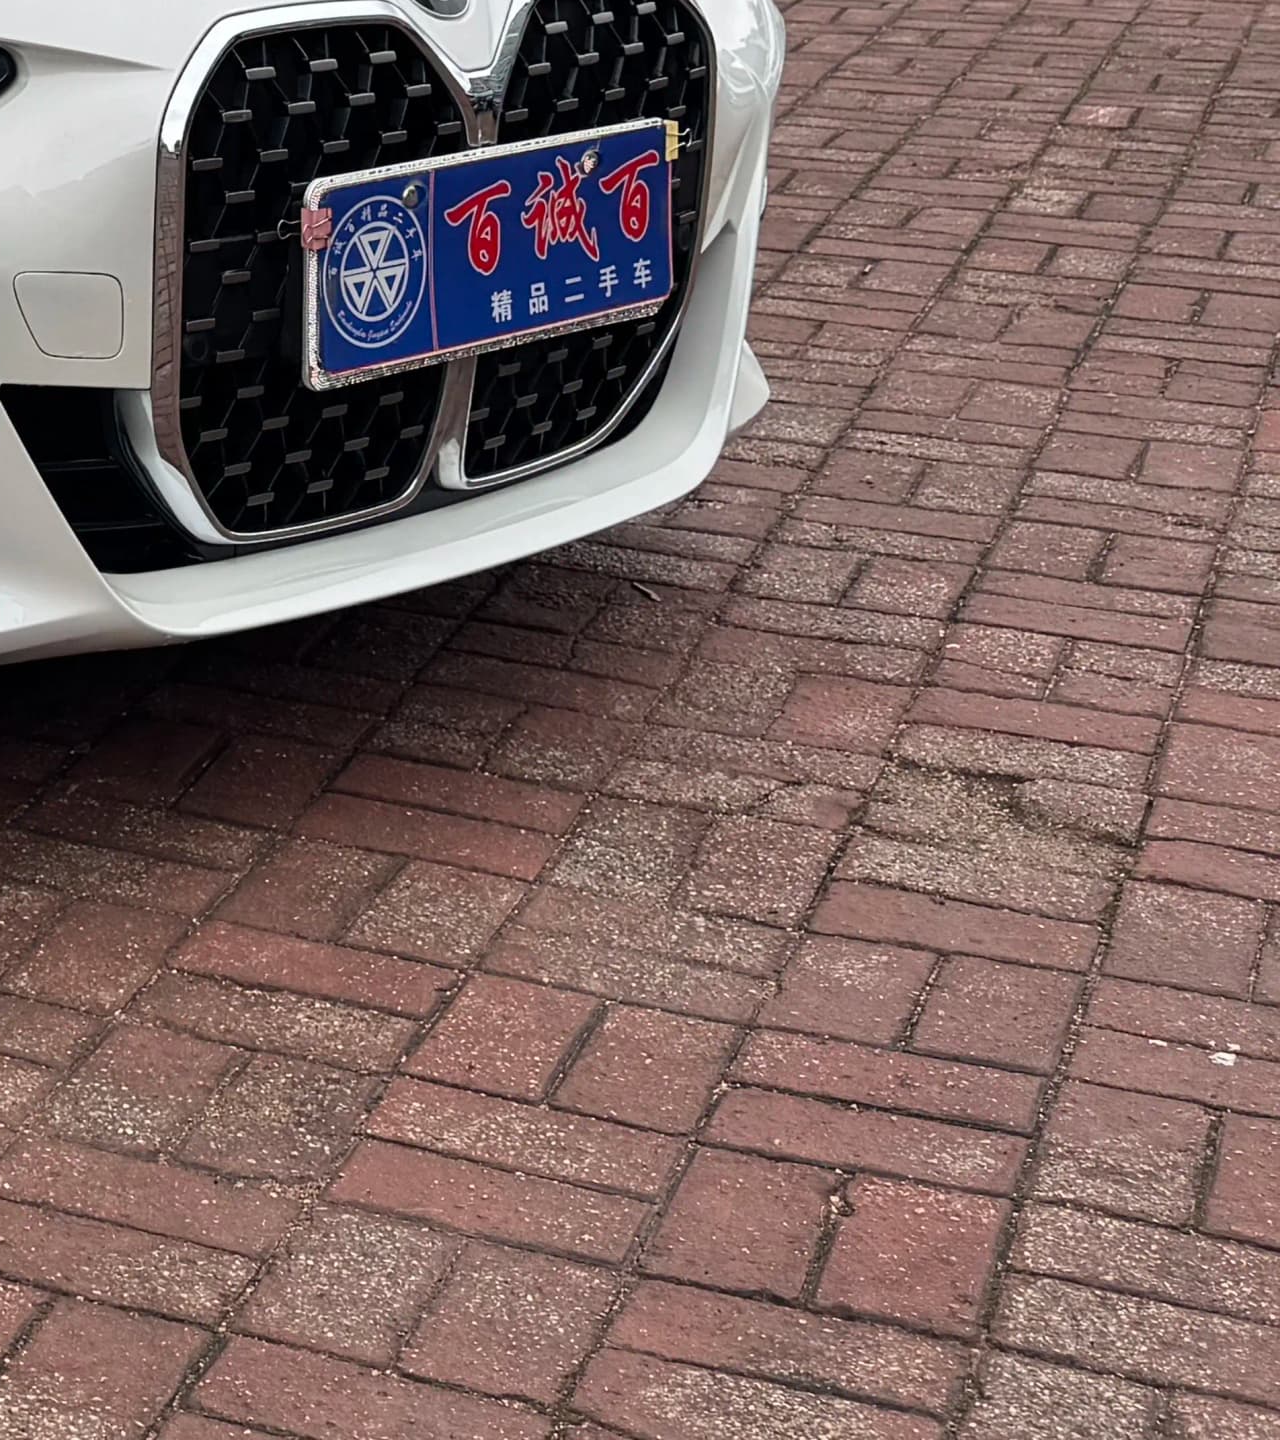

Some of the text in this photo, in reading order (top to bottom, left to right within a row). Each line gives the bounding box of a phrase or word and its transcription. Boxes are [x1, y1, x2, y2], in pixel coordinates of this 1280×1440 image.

[490, 258, 653, 324] 精品二手车
